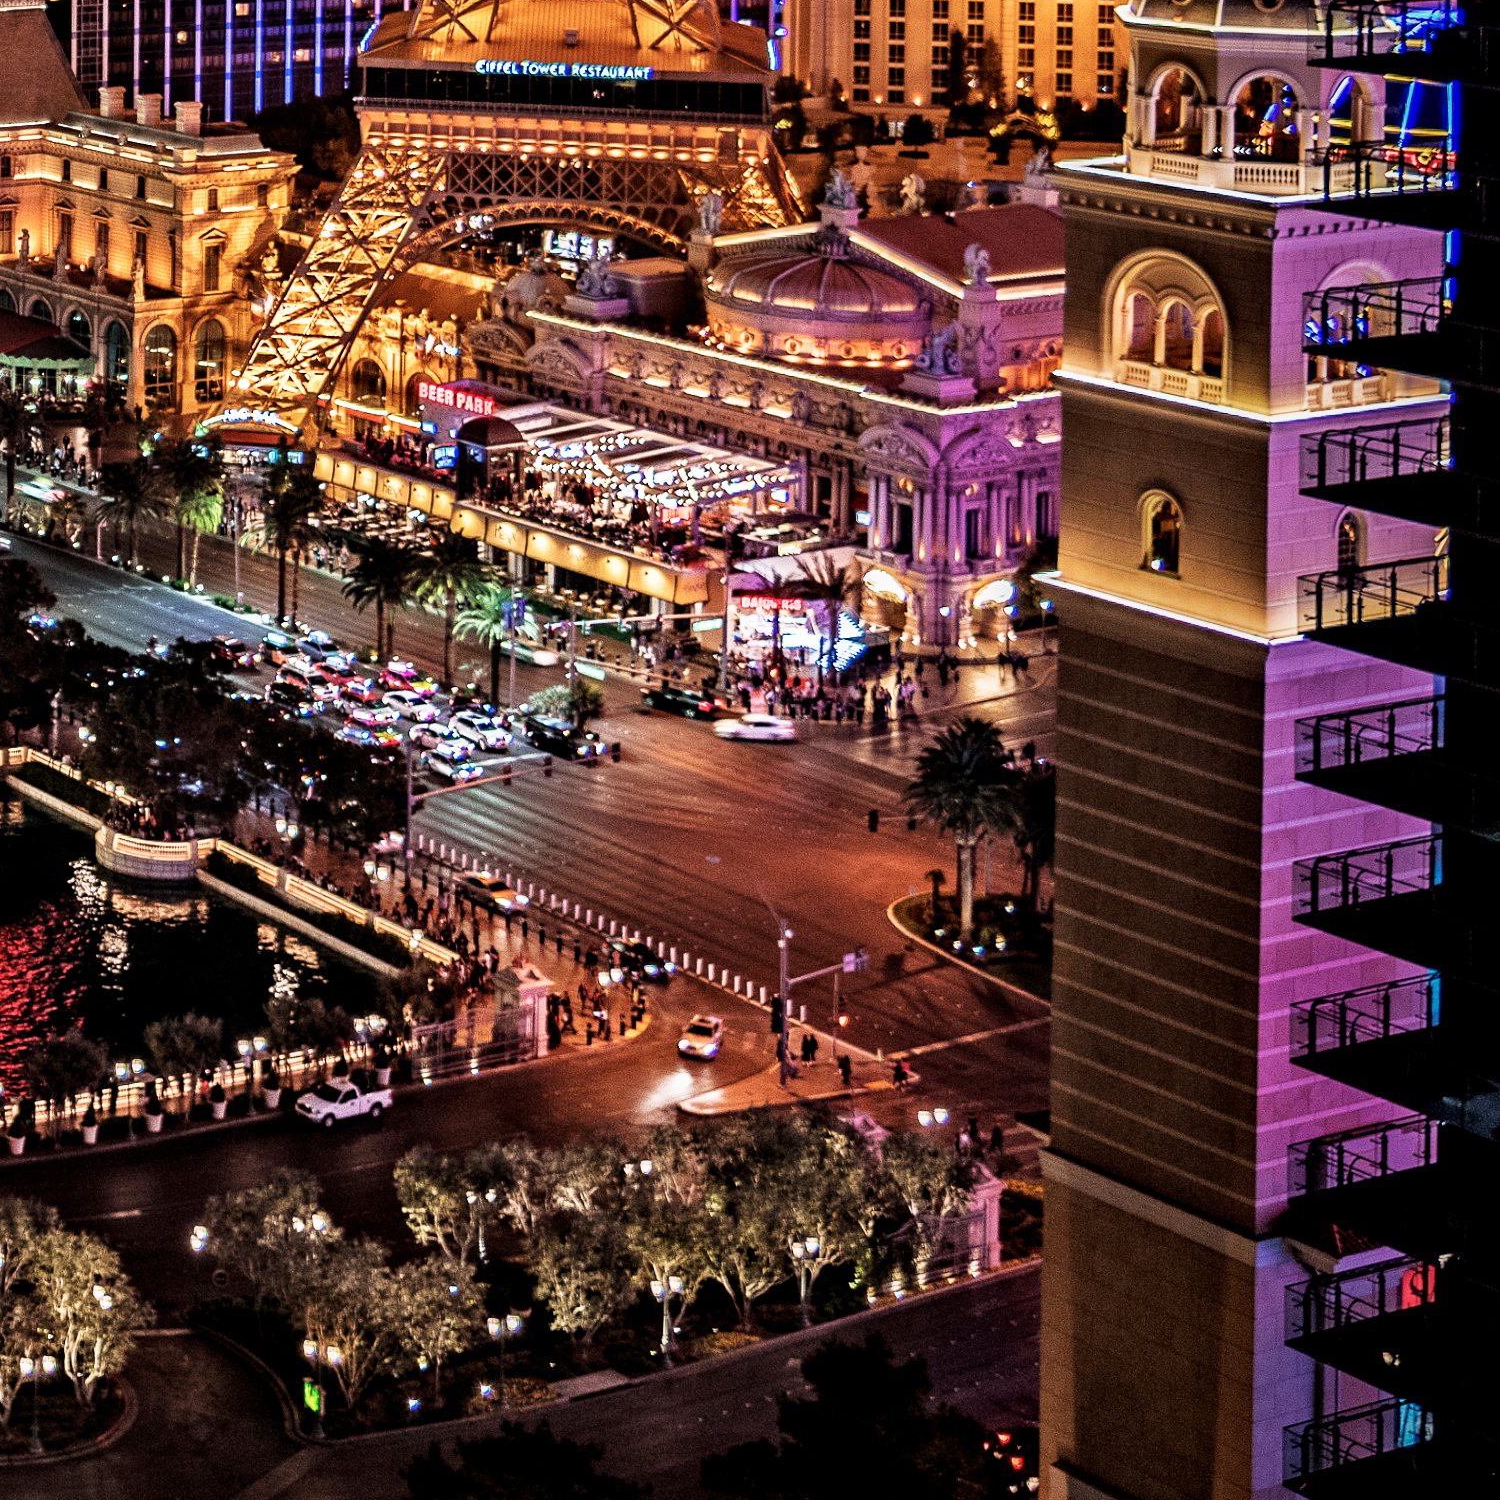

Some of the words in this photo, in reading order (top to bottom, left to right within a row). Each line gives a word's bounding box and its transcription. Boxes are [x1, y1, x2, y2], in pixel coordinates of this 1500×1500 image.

[475, 59, 519, 75] EIFFEL
[520, 60, 569, 77] TOWER
[571, 62, 654, 81] RESTAURANT
[418, 382, 454, 407] BEER
[456, 390, 495, 416] PARK
